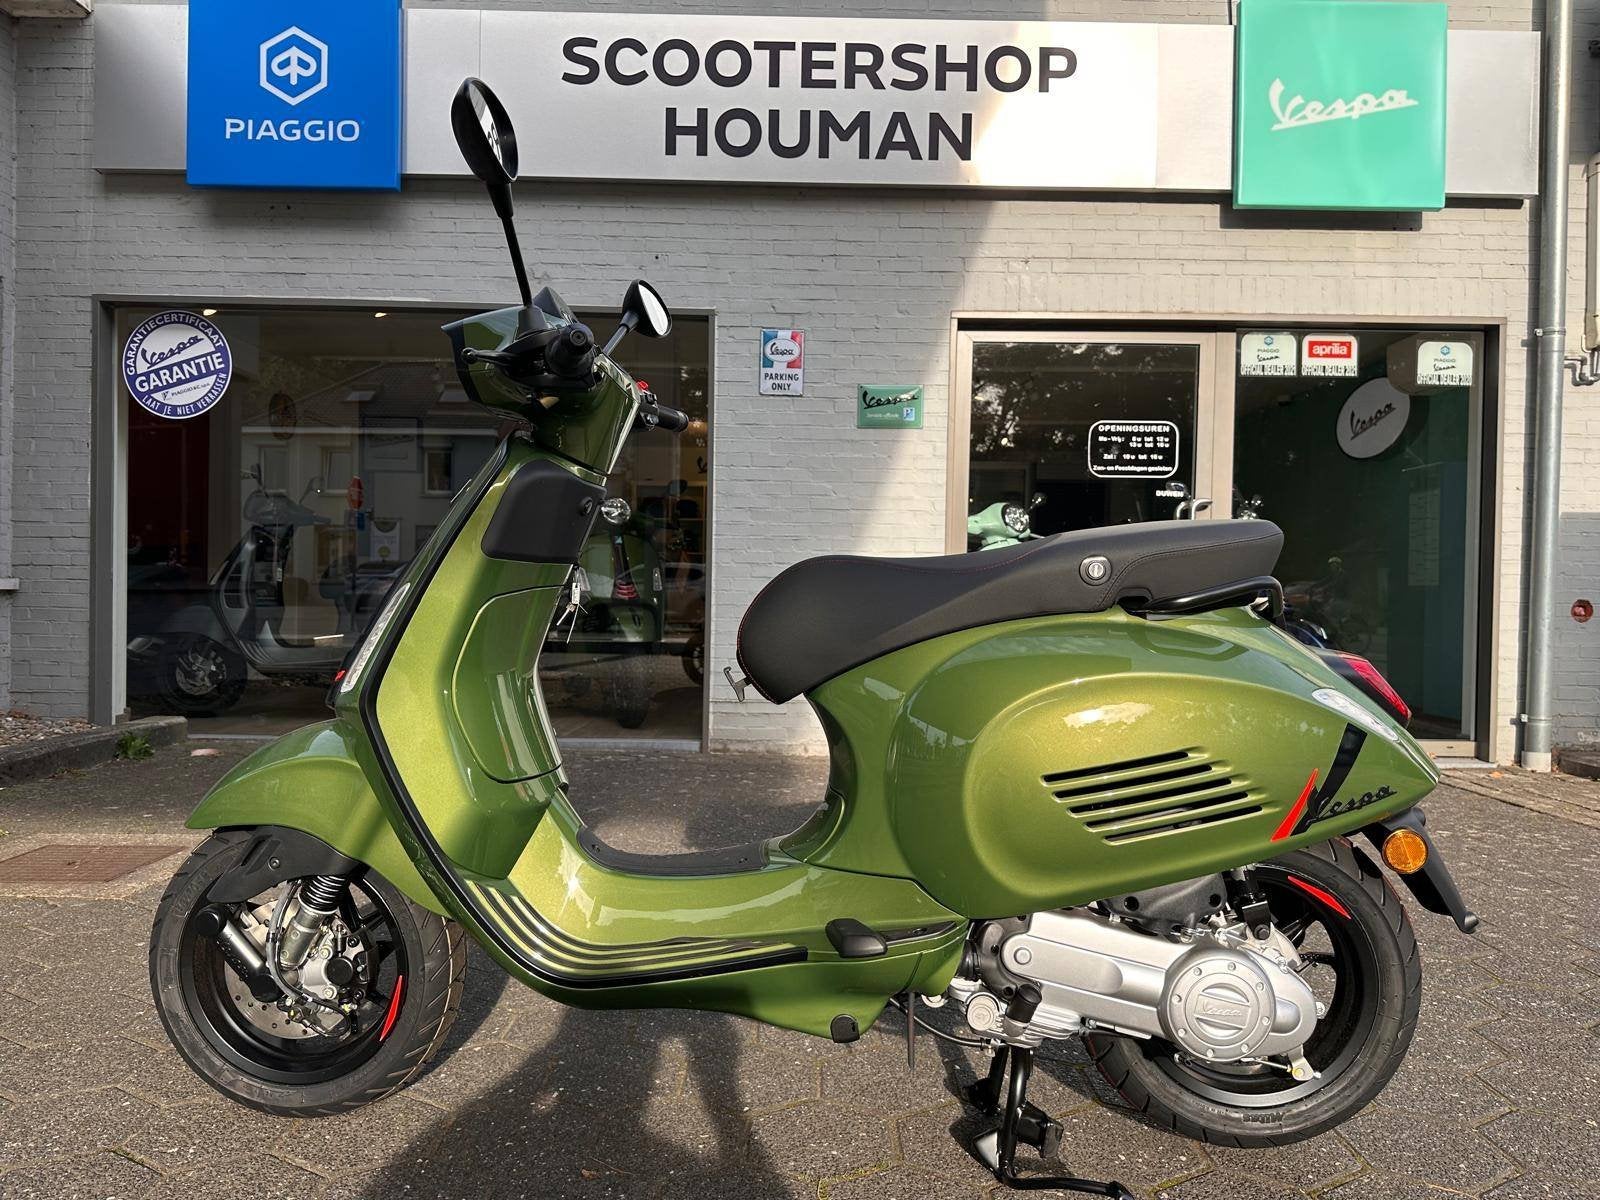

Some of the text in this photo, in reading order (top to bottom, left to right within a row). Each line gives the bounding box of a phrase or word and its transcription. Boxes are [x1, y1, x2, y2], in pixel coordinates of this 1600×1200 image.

[561, 36, 1077, 93] SCOOTERSHOP
[1268, 77, 1419, 131] Vespa
[224, 118, 361, 142] PIAGGIO
[664, 107, 973, 161] HOUMAN
[127, 313, 224, 376] GARANTIECERTIFICAAT
[141, 335, 204, 370] Vespa
[769, 342, 795, 356] Vespa
[1312, 343, 1348, 357] aprilia
[135, 353, 225, 393] GARANTIE
[764, 372, 800, 382] PARKING
[771, 382, 792, 391] ONLY
[142, 395, 160, 410] LAAT
[162, 406, 172, 416] JE
[177, 405, 195, 415] NIET
[197, 373, 227, 409] VERRASSEN
[1098, 424, 1170, 433] OPENINGSUREN
[1350, 402, 1397, 441] Vespa
[1305, 785, 1398, 823] Vespa
